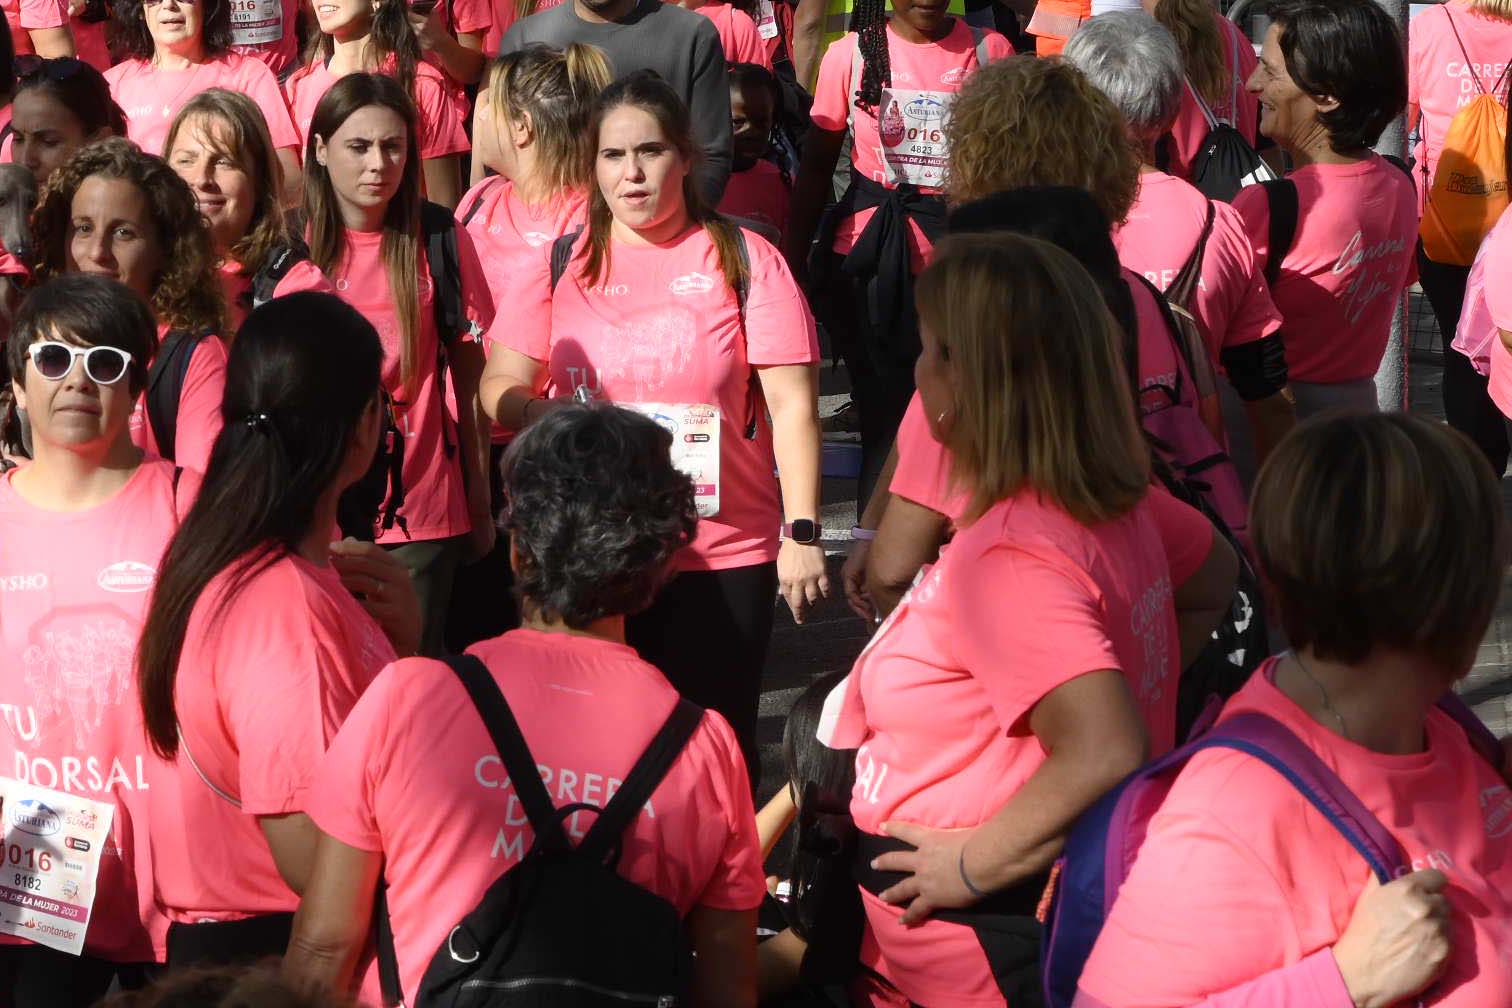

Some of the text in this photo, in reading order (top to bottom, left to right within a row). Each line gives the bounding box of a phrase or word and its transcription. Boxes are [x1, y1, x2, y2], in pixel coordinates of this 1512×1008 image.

[908, 128, 941, 142] 016
[910, 145, 932, 154] 4823
[0, 703, 36, 741] TU
[15, 752, 149, 791] DORSAL
[9, 844, 53, 873] 016
[14, 872, 41, 892] 8182
[10, 892, 21, 903] DE
[22, 894, 34, 906] LA
[34, 897, 60, 913] MUJER
[61, 905, 79, 918] 2023
[35, 920, 78, 942] Santander
